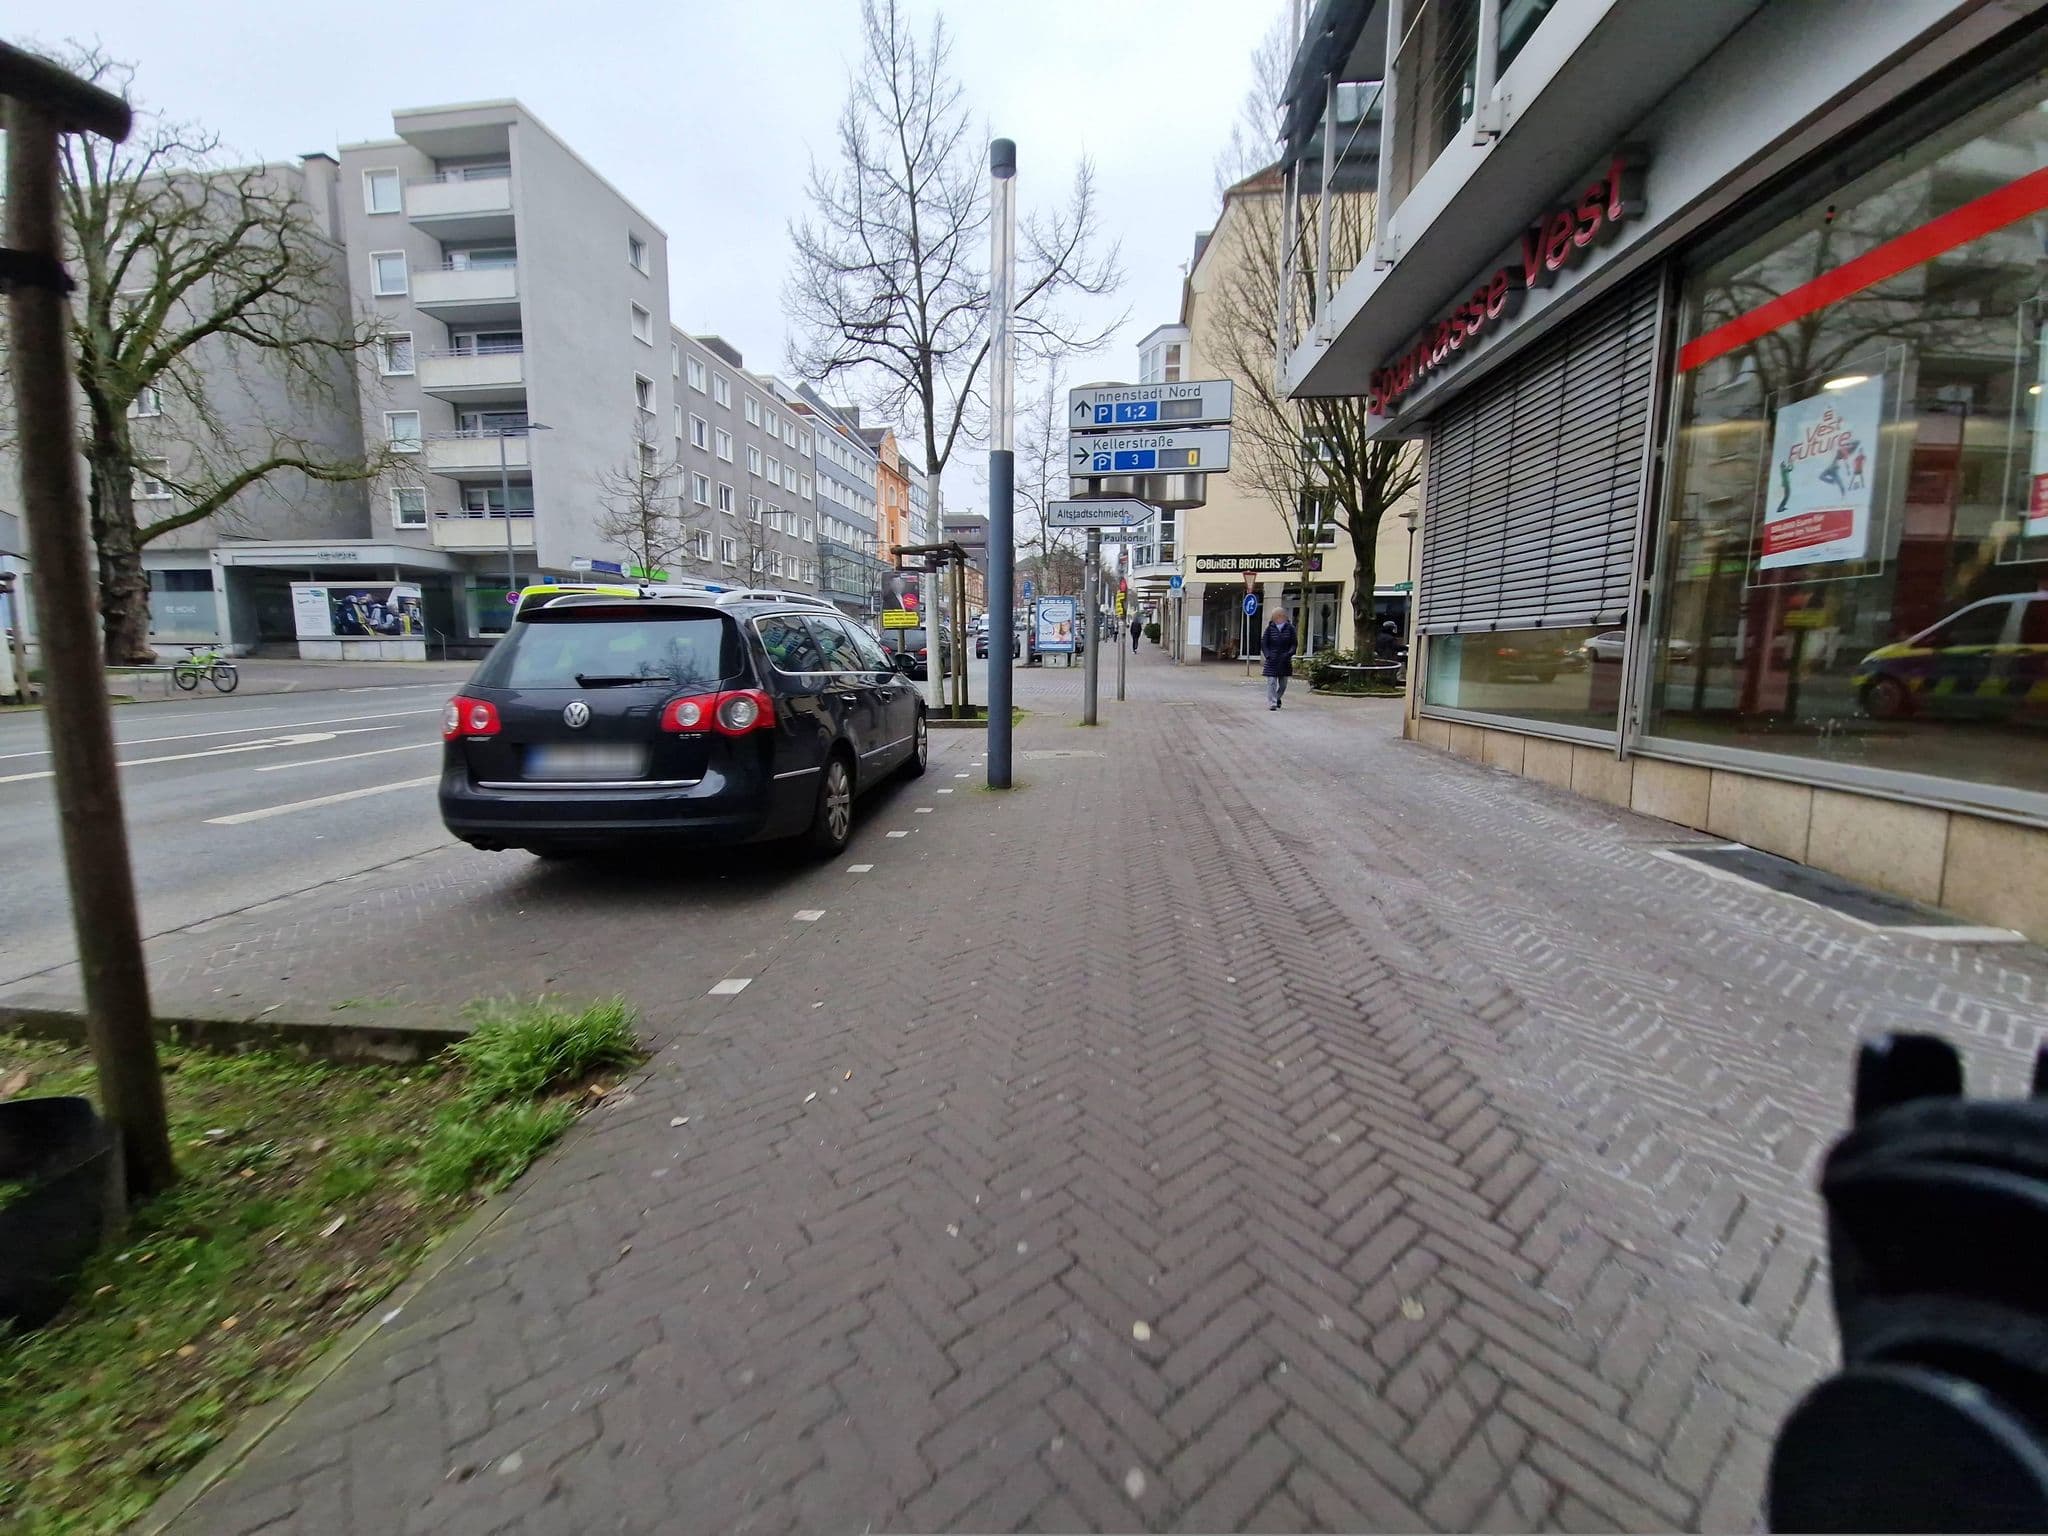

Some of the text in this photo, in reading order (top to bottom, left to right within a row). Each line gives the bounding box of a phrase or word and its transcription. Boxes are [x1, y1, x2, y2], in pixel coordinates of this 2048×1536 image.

[1369, 152, 1627, 416] Sparkasse Vest
[1094, 384, 1201, 403] Innenstadt Nord
[1124, 405, 1147, 420] 1;2
[1806, 416, 1844, 443] Vest
[1093, 436, 1174, 451] Kellerstraße
[1788, 431, 1852, 464] Future
[1131, 454, 1139, 465] 3
[1239, 558, 1281, 569] BROTHERS
